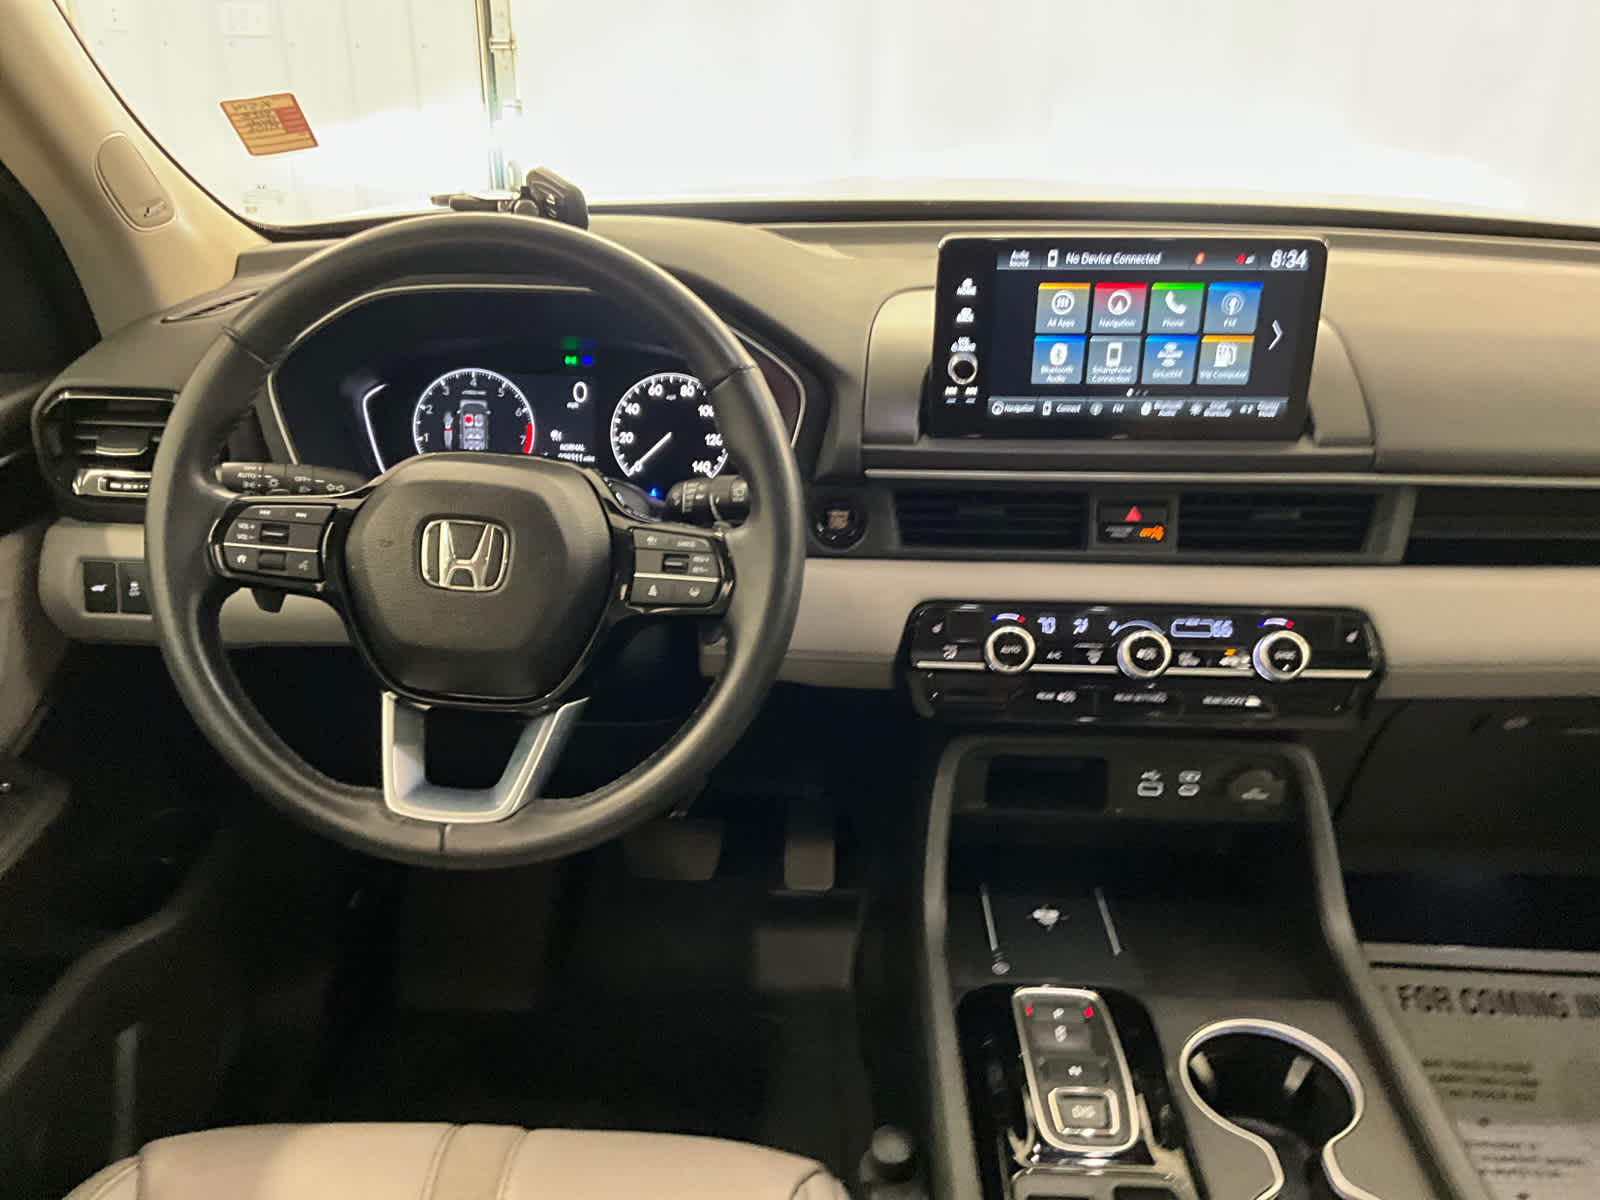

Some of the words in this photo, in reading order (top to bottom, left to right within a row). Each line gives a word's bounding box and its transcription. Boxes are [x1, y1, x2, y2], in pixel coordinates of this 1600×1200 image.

[1065, 252, 1080, 265] No
[1081, 251, 1112, 265] Device
[1113, 251, 1163, 265] Connected
[1270, 249, 1309, 268] 8:34
[470, 378, 477, 387] 4
[443, 386, 450, 396] 3
[498, 388, 505, 397] 5
[572, 381, 588, 403] 0
[648, 384, 663, 397] 60
[680, 384, 695, 397] 80
[426, 404, 433, 414] 2
[515, 407, 523, 417] 6
[624, 403, 640, 416] 40
[423, 433, 430, 443] 1
[519, 435, 527, 445] 7
[619, 432, 634, 443] 20
[634, 460, 642, 472] 0
[692, 460, 711, 473] 140
[1397, 984, 1452, 1014] FOR
